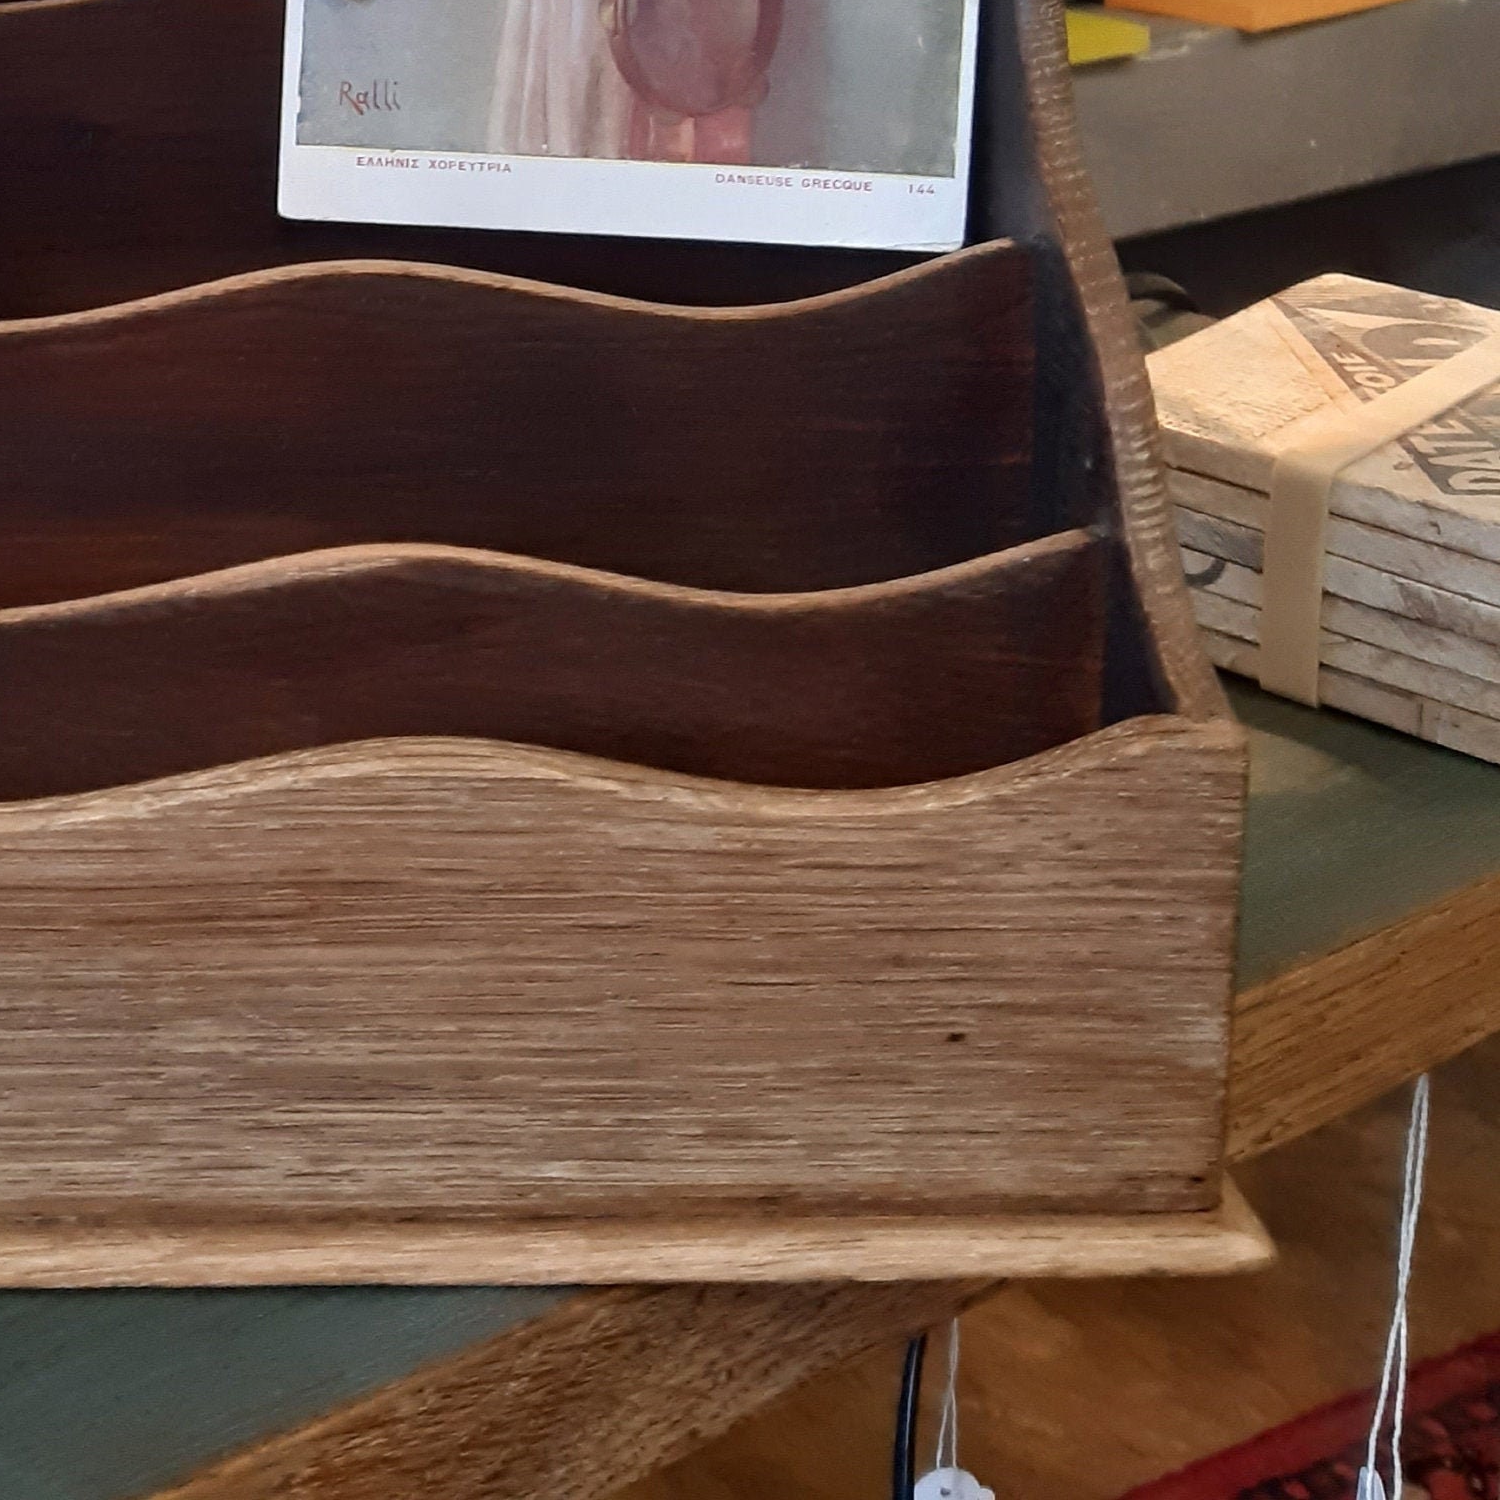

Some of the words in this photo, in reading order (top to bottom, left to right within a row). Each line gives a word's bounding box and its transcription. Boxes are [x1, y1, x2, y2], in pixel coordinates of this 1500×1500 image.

[339, 80, 401, 116] Ralli
[356, 156, 420, 169] ΕΛΛΗΝΙΣ
[428, 159, 512, 173] ΧΟΡΕΥΤΡΙΑ
[715, 173, 794, 188] DANSEUSE
[801, 178, 873, 192] GRECQUE
[908, 183, 935, 195] 144
